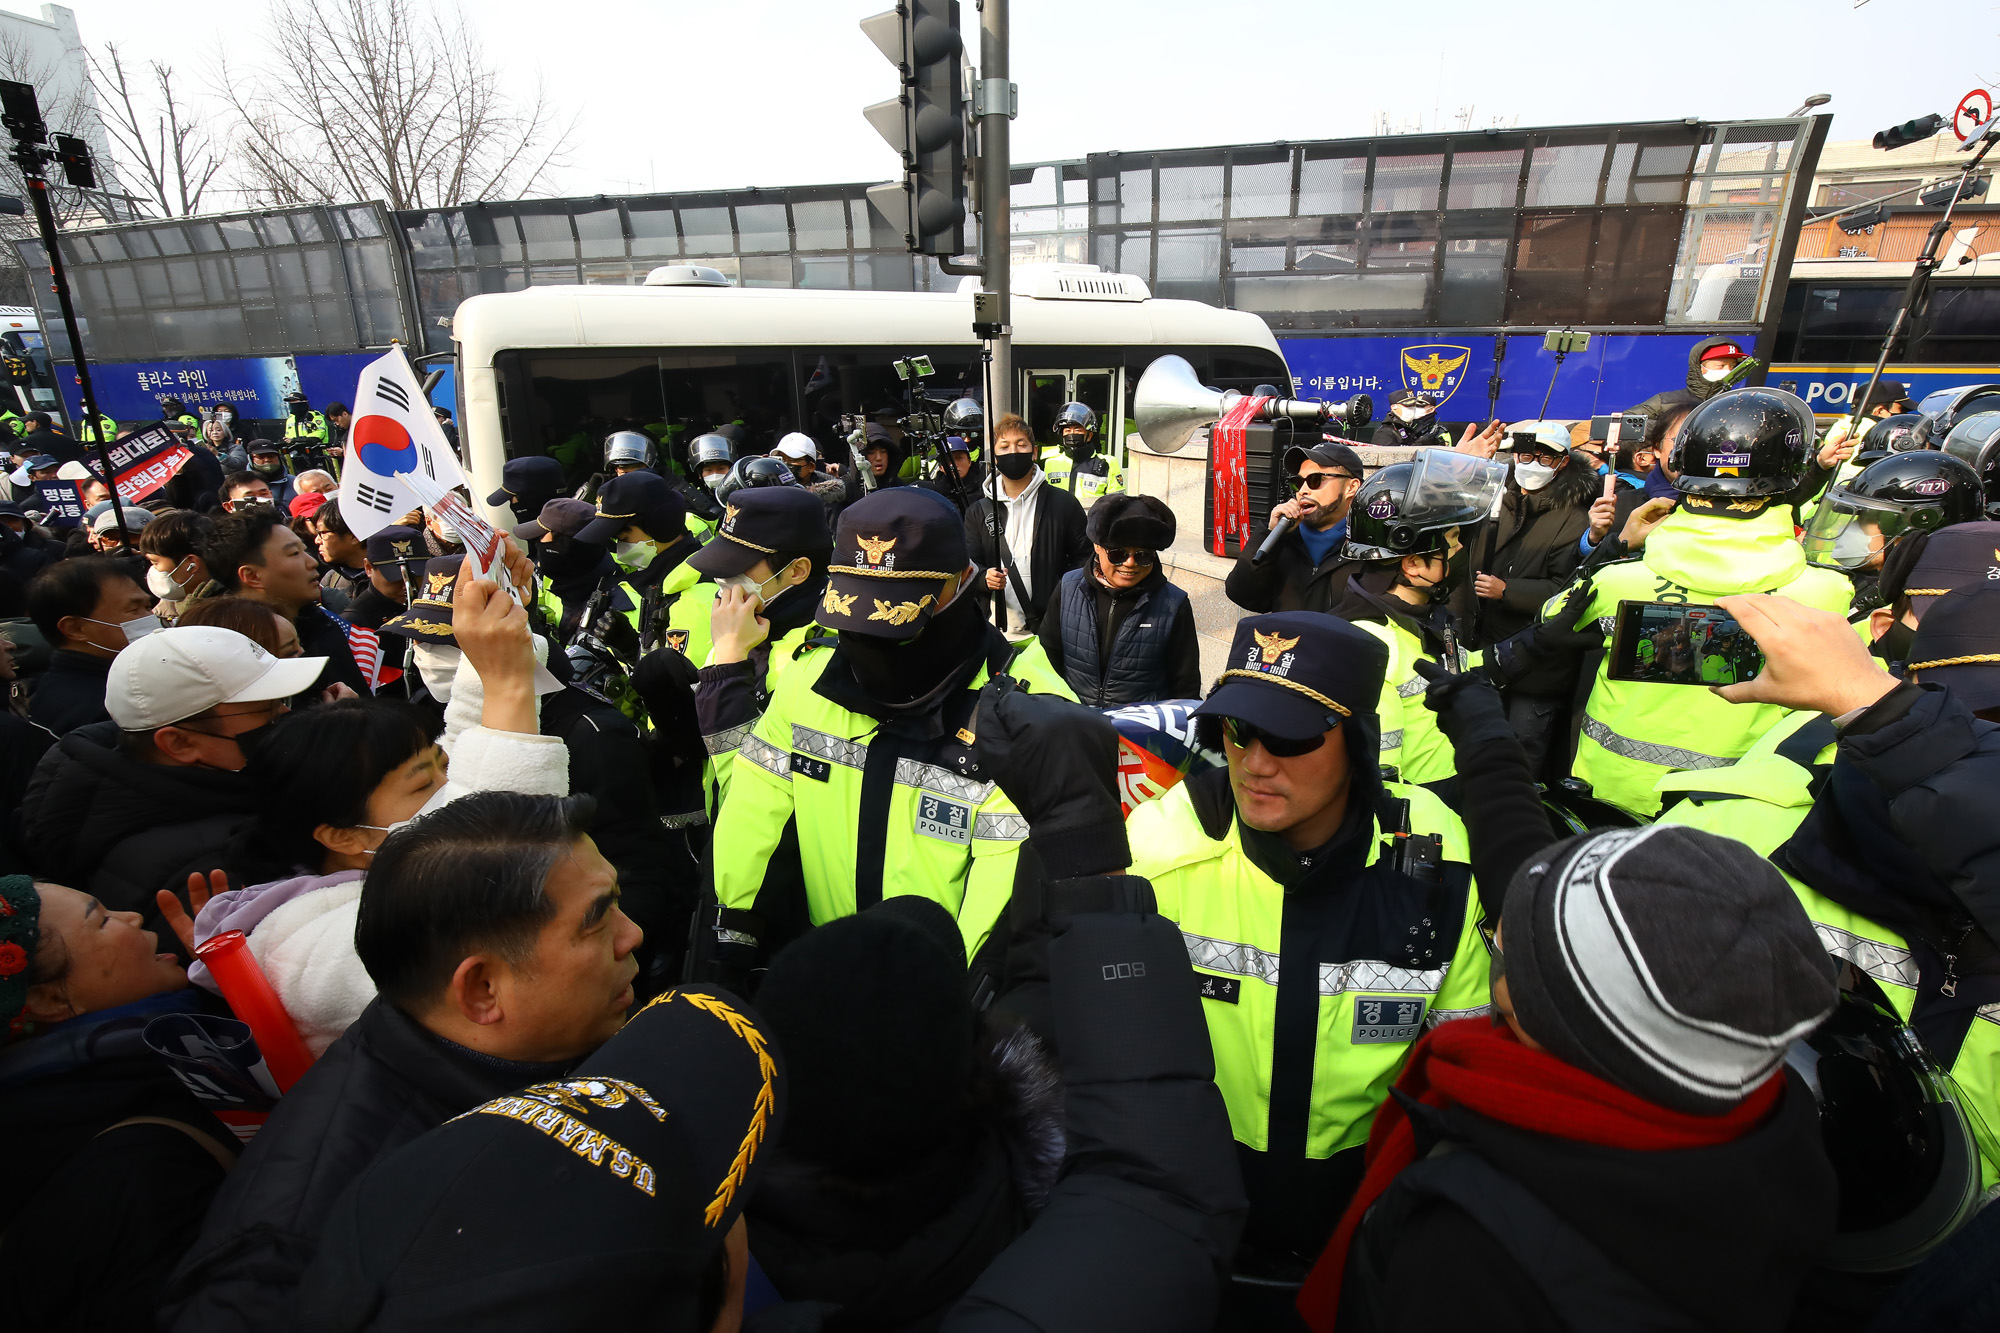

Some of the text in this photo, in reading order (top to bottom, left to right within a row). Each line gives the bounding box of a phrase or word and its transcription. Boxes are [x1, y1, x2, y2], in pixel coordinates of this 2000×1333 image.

[137, 369, 209, 391] 폴리스 라인!
[1309, 376, 1382, 390] 이름입니다.
[181, 392, 201, 403] 질서의
[202, 391, 209, 401] 또
[210, 390, 223, 401] 다른
[224, 389, 260, 401] 이름입니다.
[1708, 455, 1747, 465] 77기-서울11
[115, 448, 186, 499] 탄핵무효!
[42, 487, 76, 502] 명분
[1920, 481, 1945, 493] 77기
[1371, 504, 1391, 515] 77기
[855, 550, 896, 567] 경 찰
[1247, 646, 1296, 669] 경 찰
[922, 797, 965, 828] 경찰
[920, 821, 965, 840] POLICE
[1362, 1001, 1418, 1025] 경찰
[1358, 1027, 1414, 1039] POLICE
